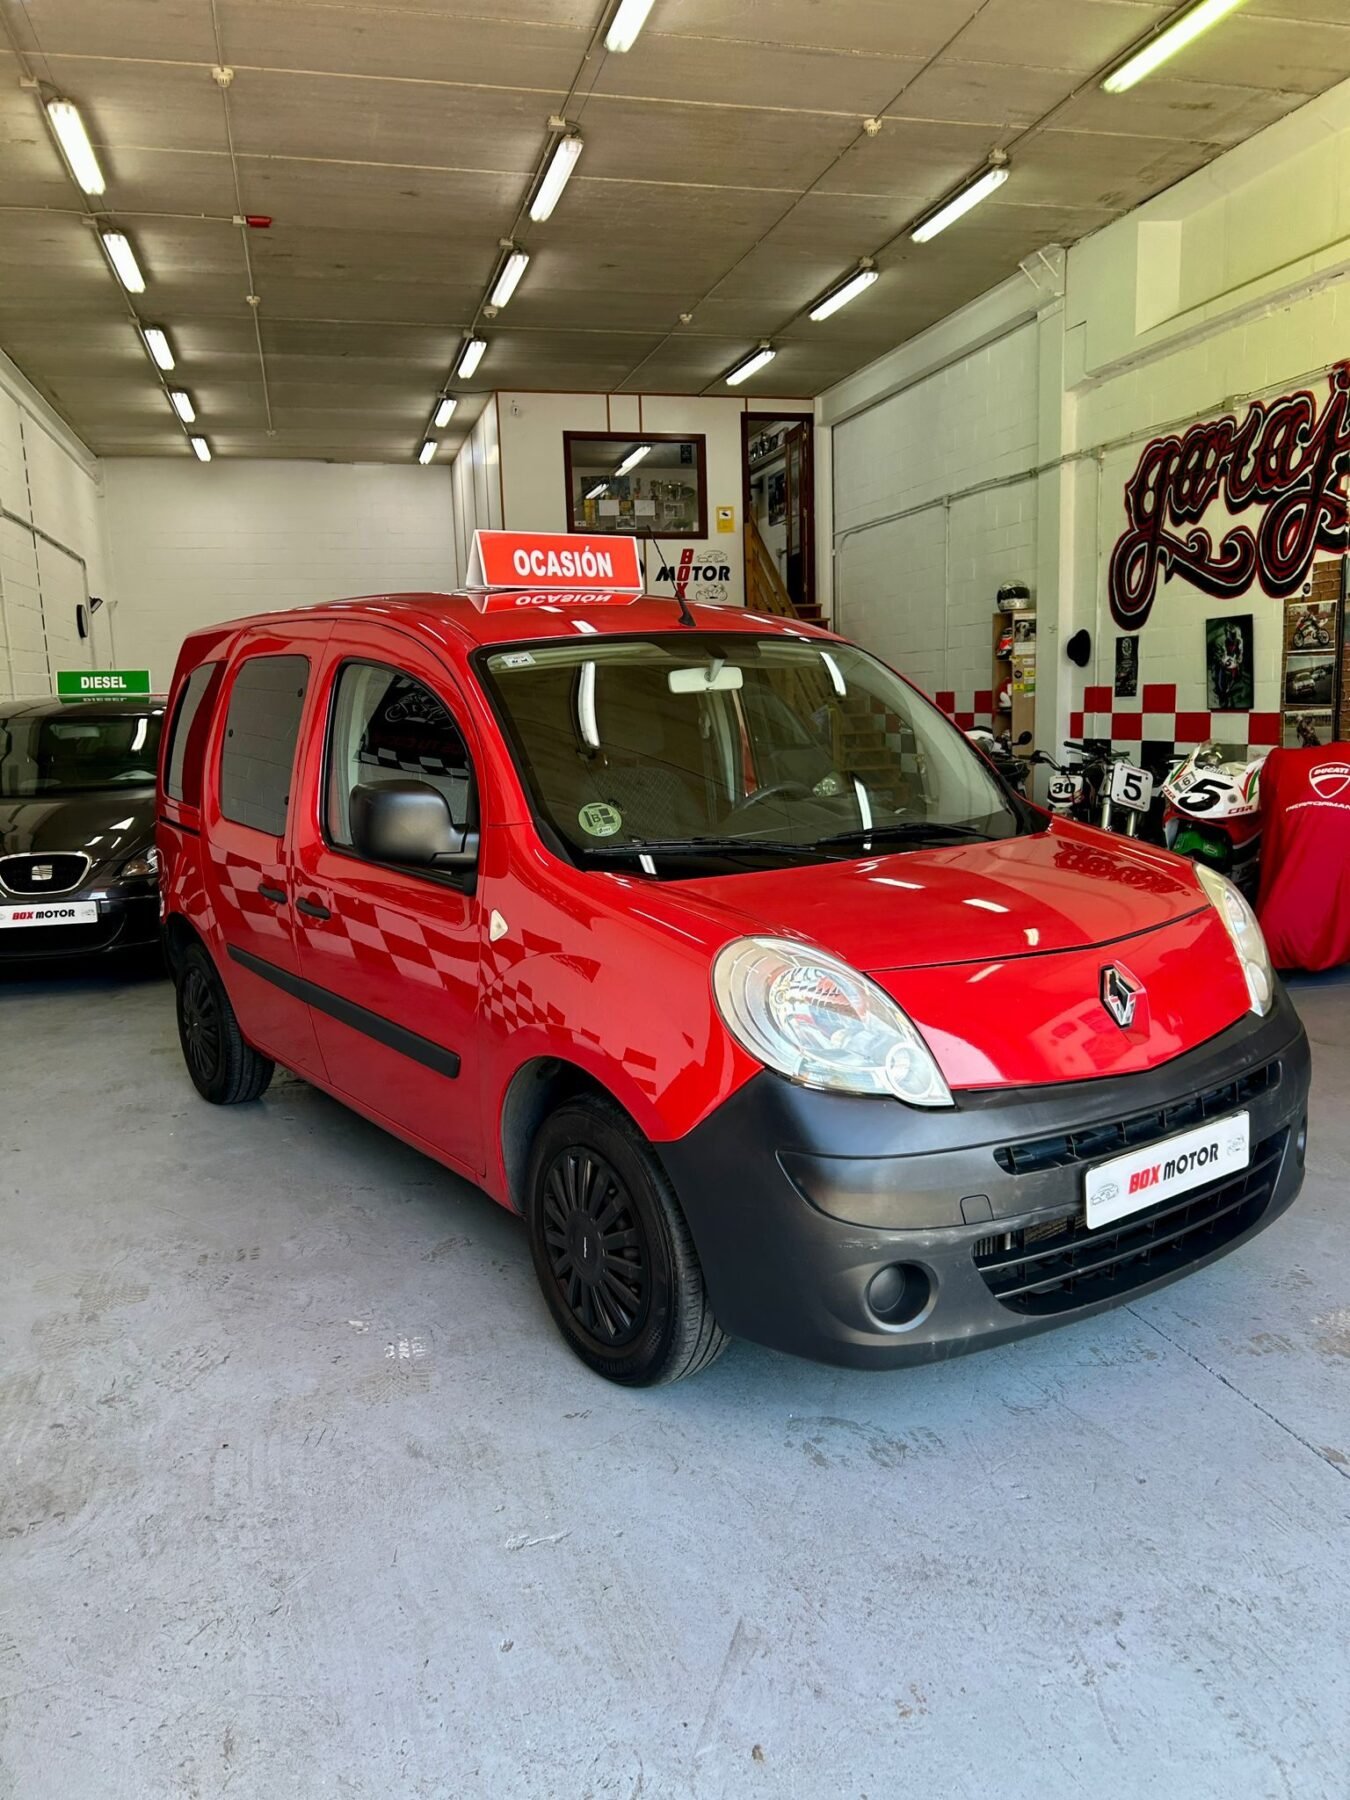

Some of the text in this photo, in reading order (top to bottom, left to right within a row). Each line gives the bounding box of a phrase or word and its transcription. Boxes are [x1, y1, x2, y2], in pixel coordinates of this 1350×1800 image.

[1109, 360, 1350, 631] garaj
[513, 546, 613, 578] OCASIÓN
[81, 676, 127, 689] DIESEL
[1314, 767, 1349, 775] DUCATI
[1052, 782, 1076, 794] 30
[1123, 772, 1143, 801] 5
[1177, 778, 1234, 812] 5
[12, 908, 76, 921] BOX MOTOR
[1128, 1143, 1219, 1195] BOX MOTOR
